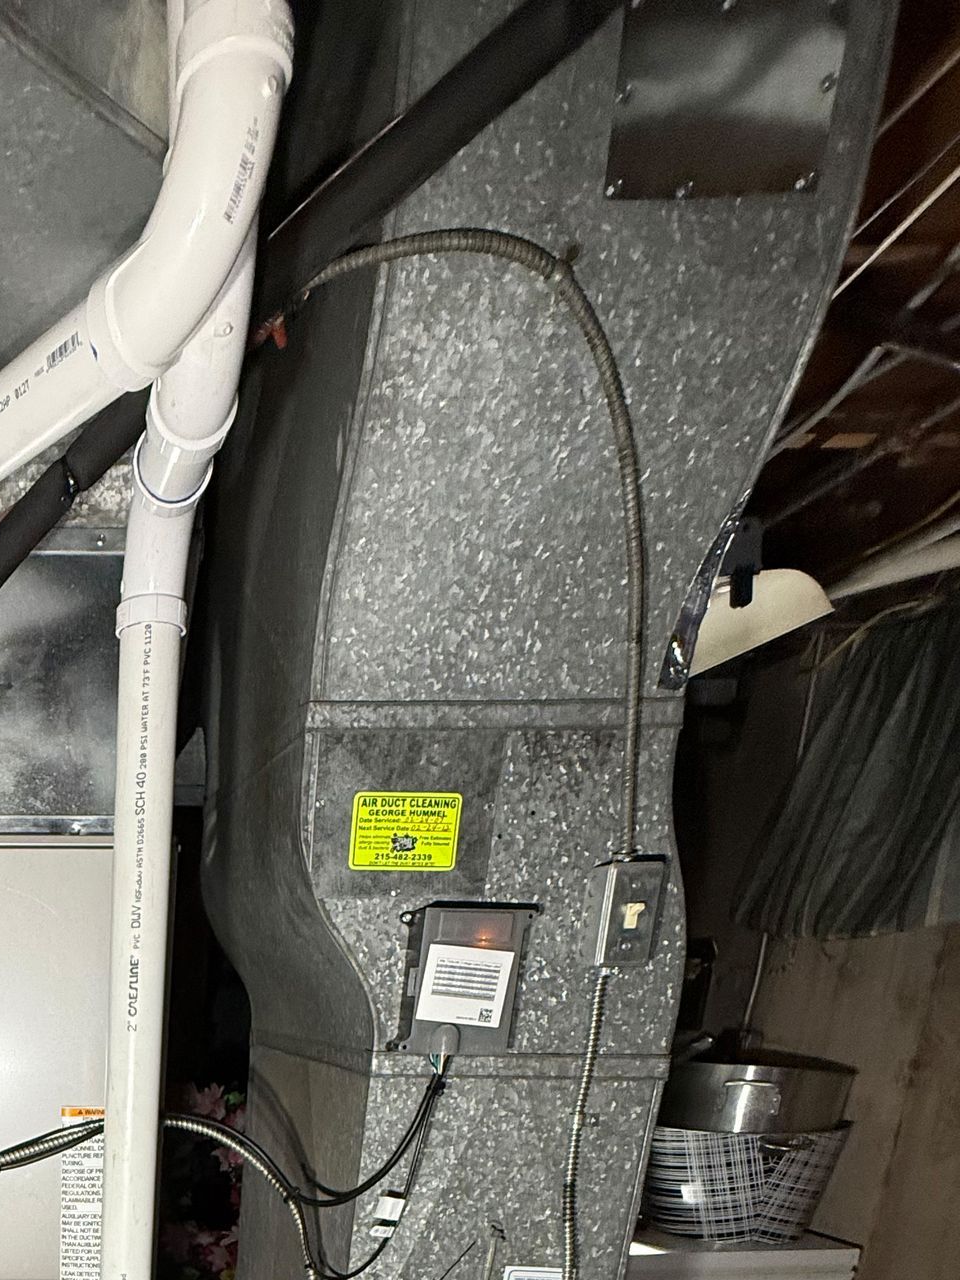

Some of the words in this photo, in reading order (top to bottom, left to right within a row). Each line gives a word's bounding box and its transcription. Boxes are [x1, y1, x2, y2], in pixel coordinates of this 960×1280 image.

[144, 624, 152, 646] 1120
[143, 648, 151, 666] PVC
[142, 691, 150, 702] AT
[140, 704, 149, 733] WATER
[139, 735, 148, 750] PSI
[136, 772, 147, 789] 40
[135, 791, 146, 816] SCH
[361, 798, 378, 807] AIR
[381, 798, 407, 808] DUCT
[409, 799, 457, 809] CLEANING
[368, 809, 406, 817] GEORGE
[409, 810, 447, 818] HUMMEL
[136, 818, 145, 844] D2665
[136, 847, 144, 868] ASTM
[374, 853, 432, 861] 215-482-2339
[131, 904, 142, 929] DWV
[133, 934, 141, 950] PVC
